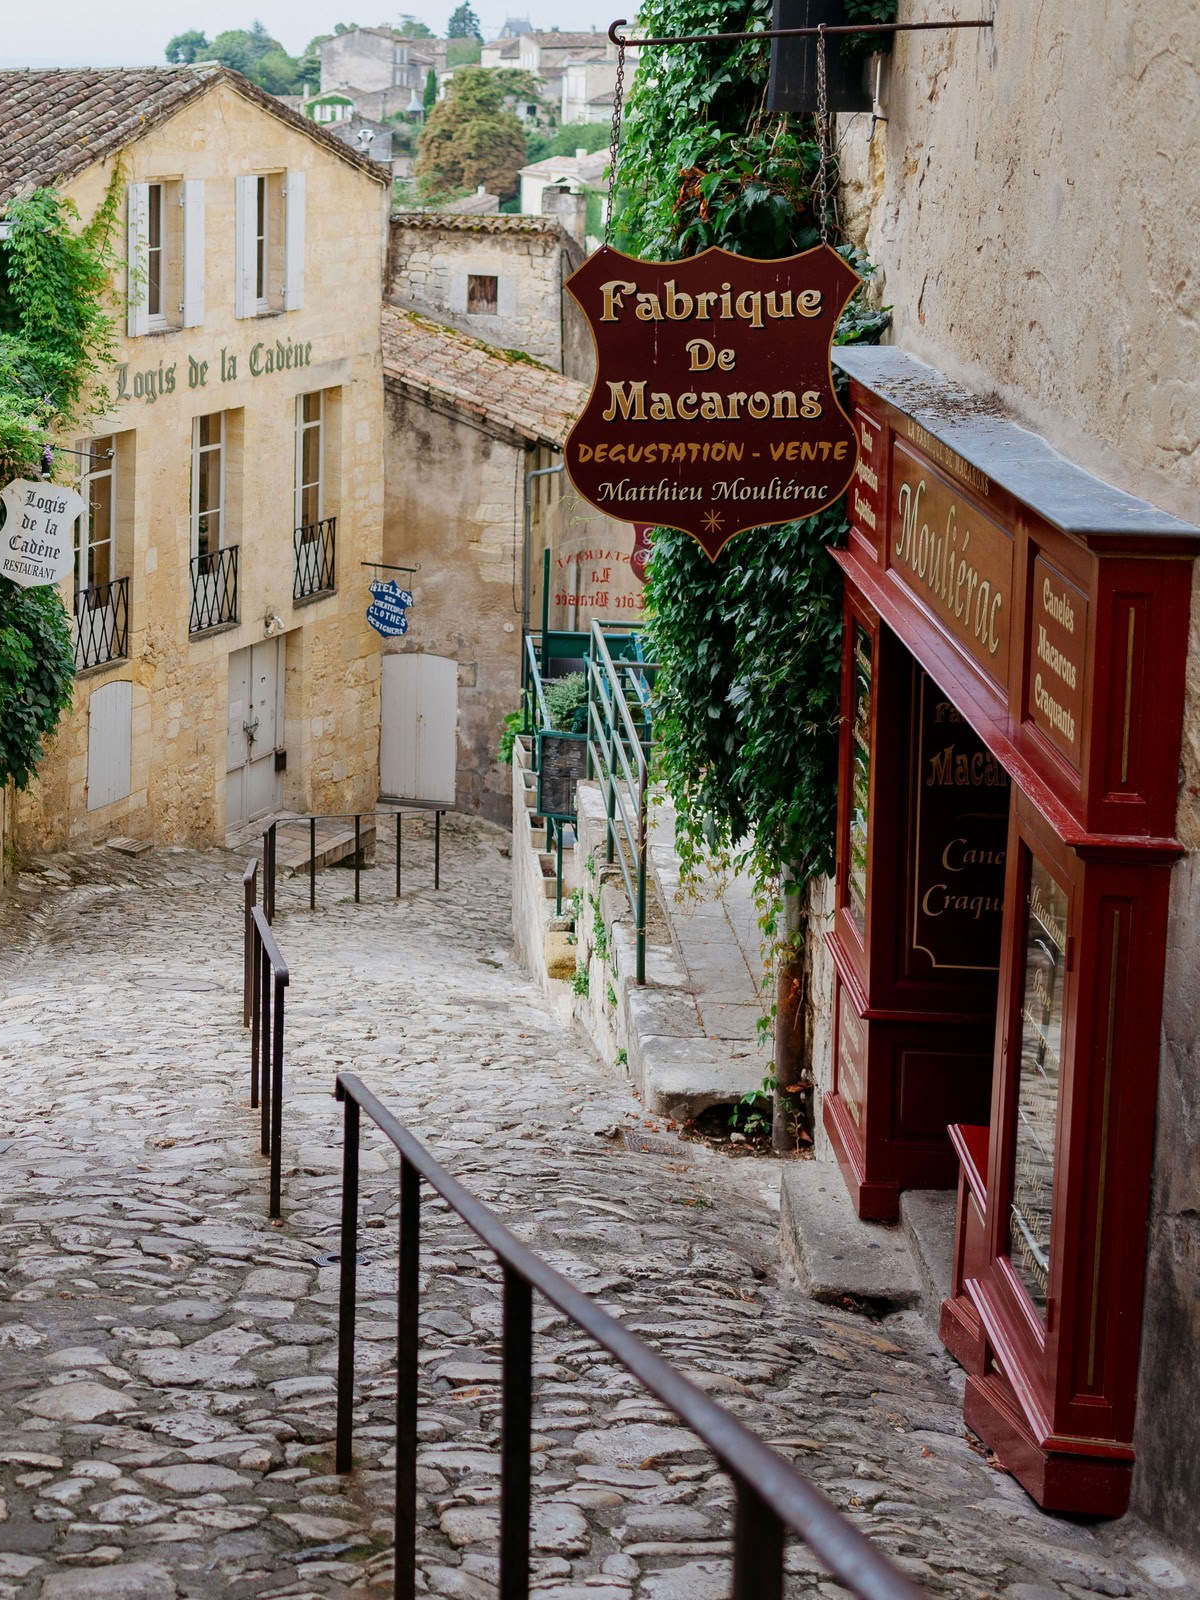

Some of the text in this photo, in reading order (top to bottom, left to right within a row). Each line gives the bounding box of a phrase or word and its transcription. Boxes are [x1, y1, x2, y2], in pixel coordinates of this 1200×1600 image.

[599, 279, 822, 328] Fabrique
[114, 336, 313, 404] Logis de la Cadène
[686, 338, 736, 372] De
[602, 380, 823, 421] Macarons
[578, 441, 745, 464] DEGUSTATION
[769, 440, 848, 462] VENTE
[24, 490, 68, 514] Logis
[597, 476, 829, 502] Matthieu Mouliérac
[21, 513, 58, 536] de la
[9, 534, 61, 560] Cadène
[2, 558, 57, 580] RESTAURANT
[895, 479, 1002, 654] Mouliérac
[369, 606, 406, 627] CLOTHES
[1043, 577, 1075, 634] Canelés
[1037, 623, 1077, 691] Macarons
[1034, 672, 1075, 744] Craquants
[942, 838, 1006, 872] Cane
[922, 884, 1005, 920] Craqu
